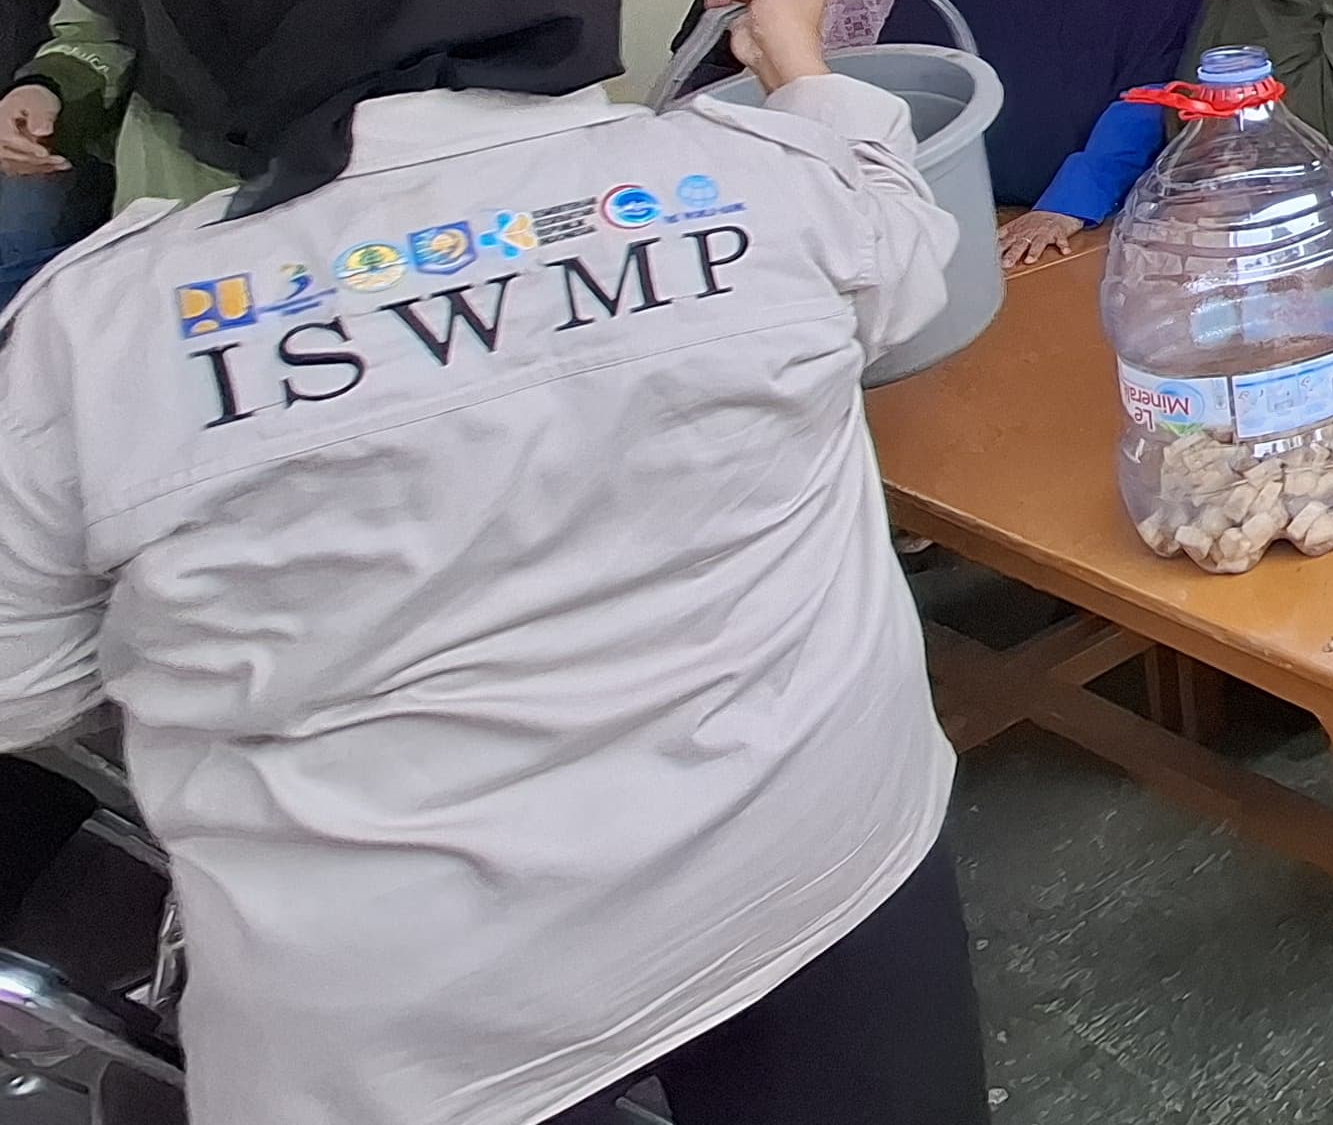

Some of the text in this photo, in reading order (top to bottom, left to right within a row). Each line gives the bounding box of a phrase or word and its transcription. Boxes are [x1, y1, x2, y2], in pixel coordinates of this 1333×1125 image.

[189, 224, 750, 428] ISWMP
[1125, 387, 1190, 416] Mineral
[1134, 406, 1155, 432] Le
